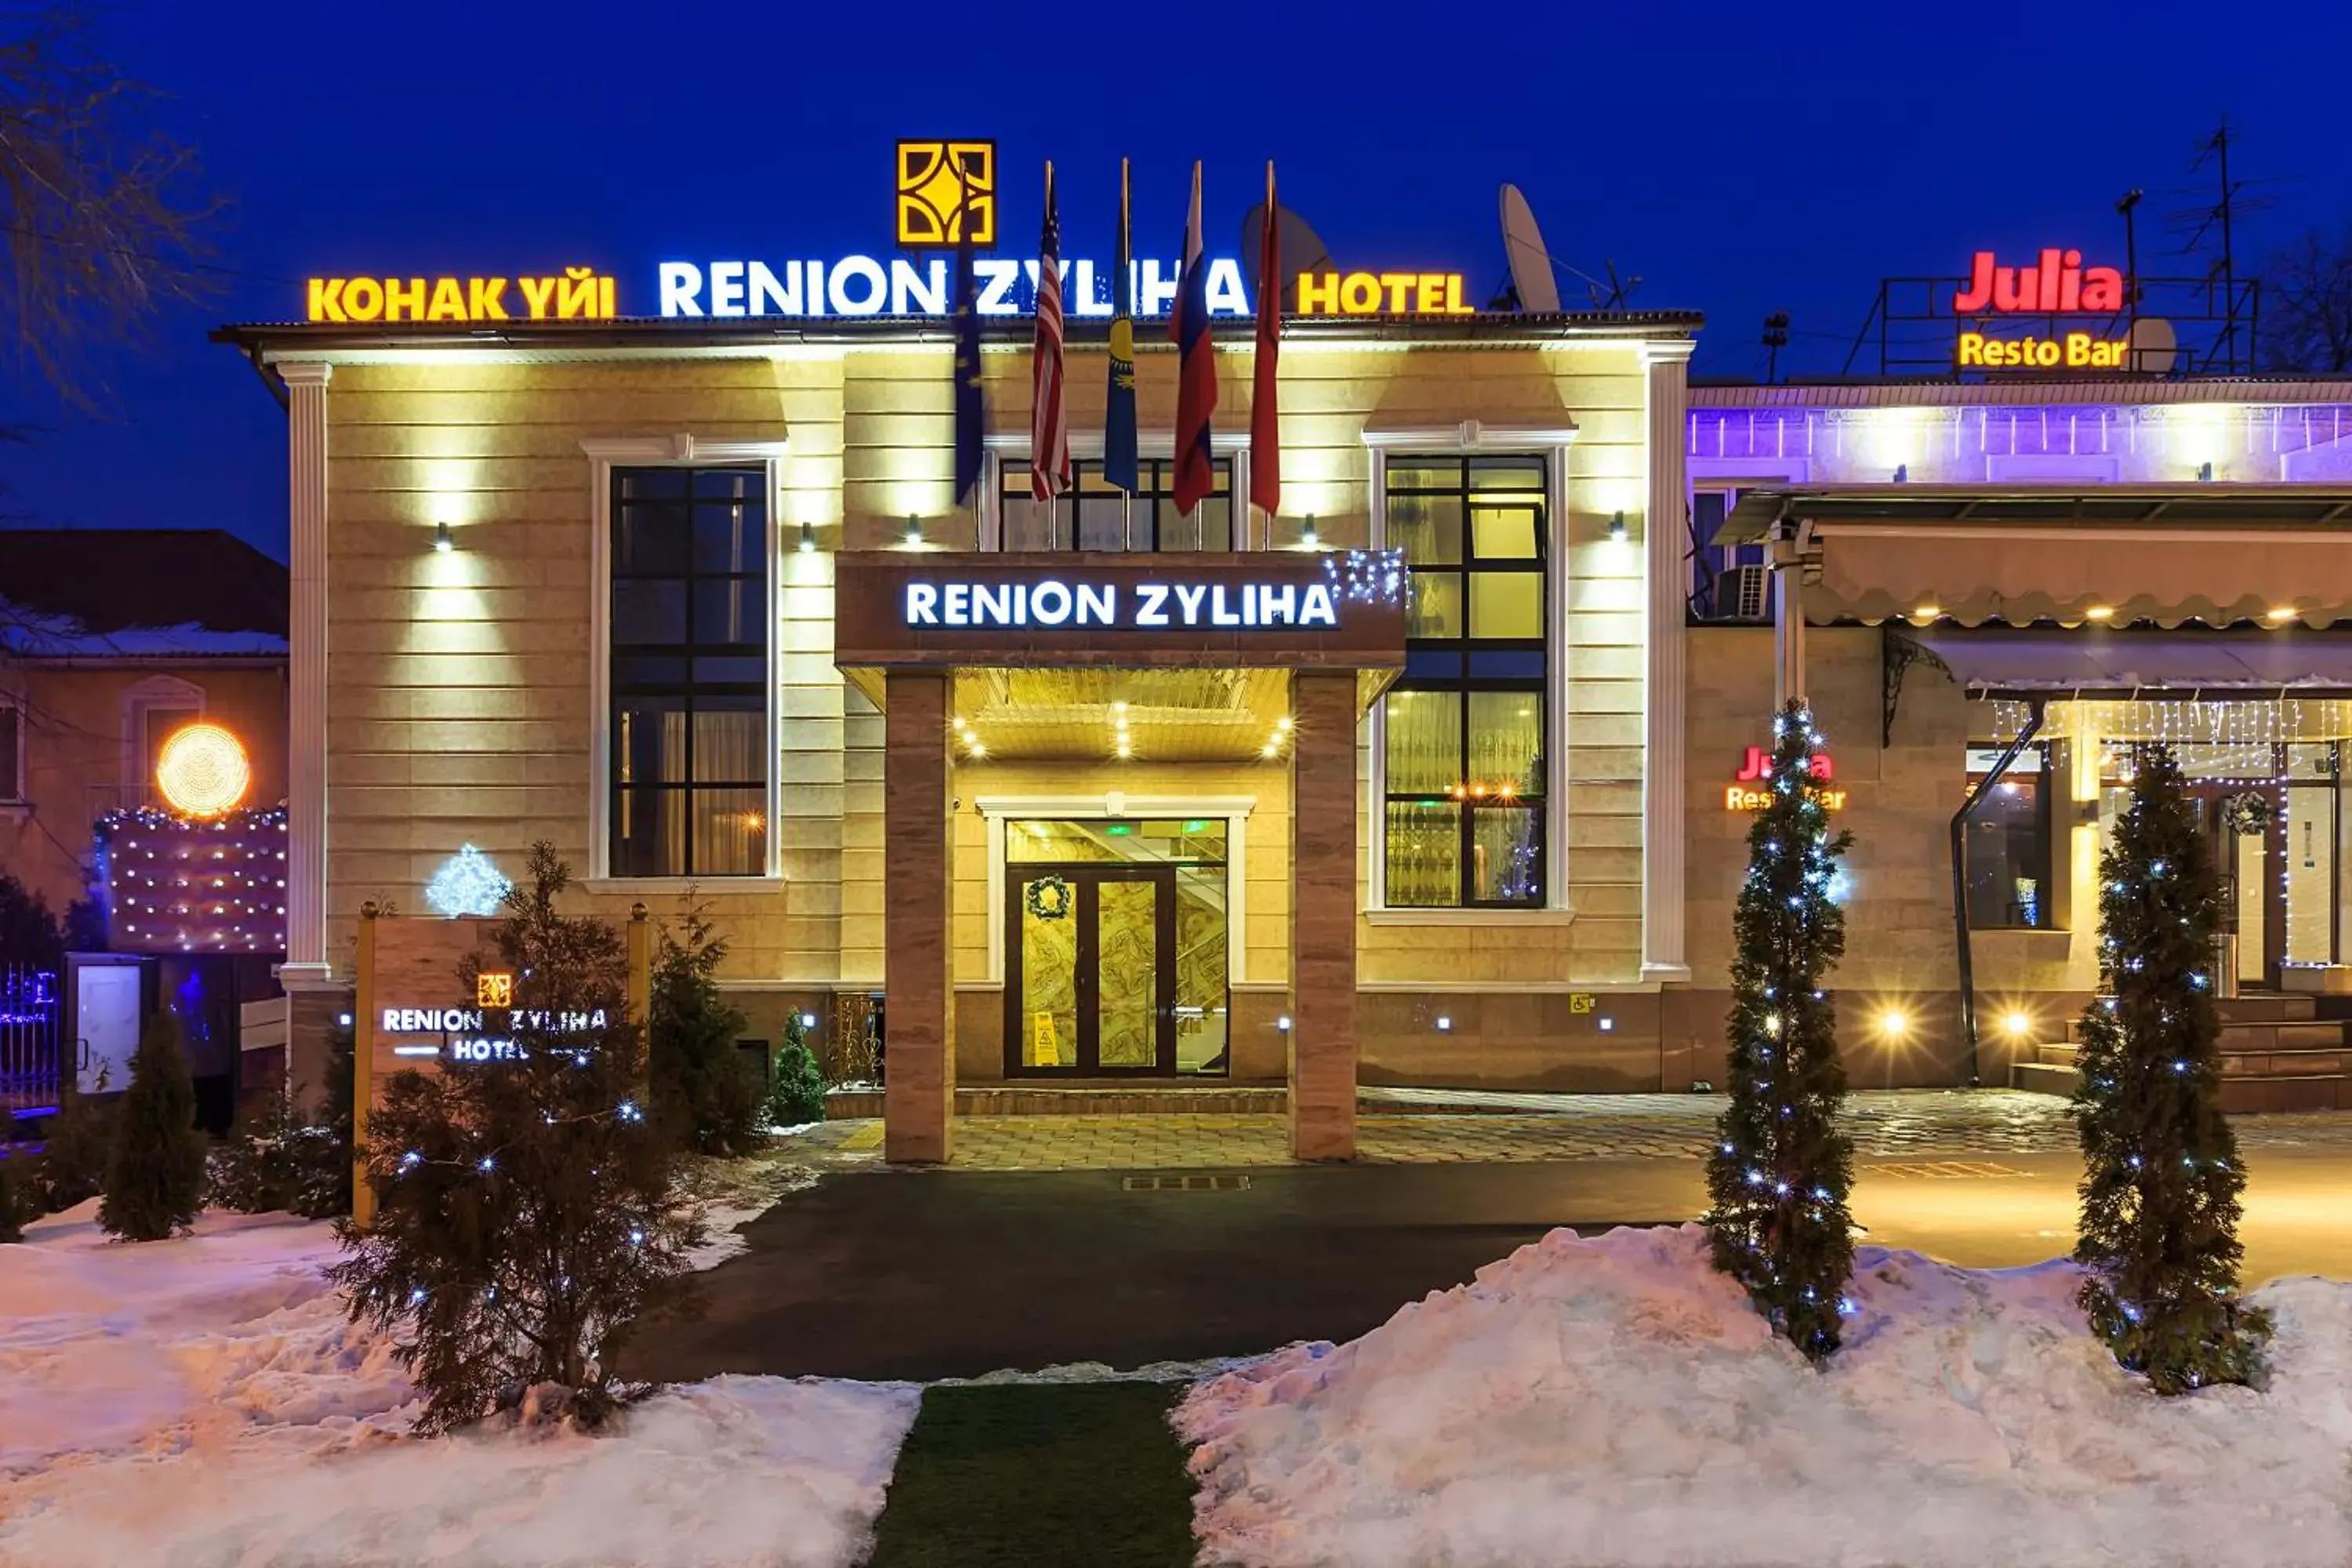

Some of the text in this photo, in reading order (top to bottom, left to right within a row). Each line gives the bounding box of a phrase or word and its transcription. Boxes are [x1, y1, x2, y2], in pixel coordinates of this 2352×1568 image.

[659, 255, 947, 317] RENION
[1298, 272, 1475, 314] HOTEL
[1955, 249, 2122, 311] Julia
[1960, 332, 2128, 366] Resto Bar
[907, 580, 1336, 625] RENION ZYLIHA
[1726, 786, 1776, 811] Res
[383, 1009, 483, 1032] RENION
[454, 1039, 529, 1060] HOTEL
